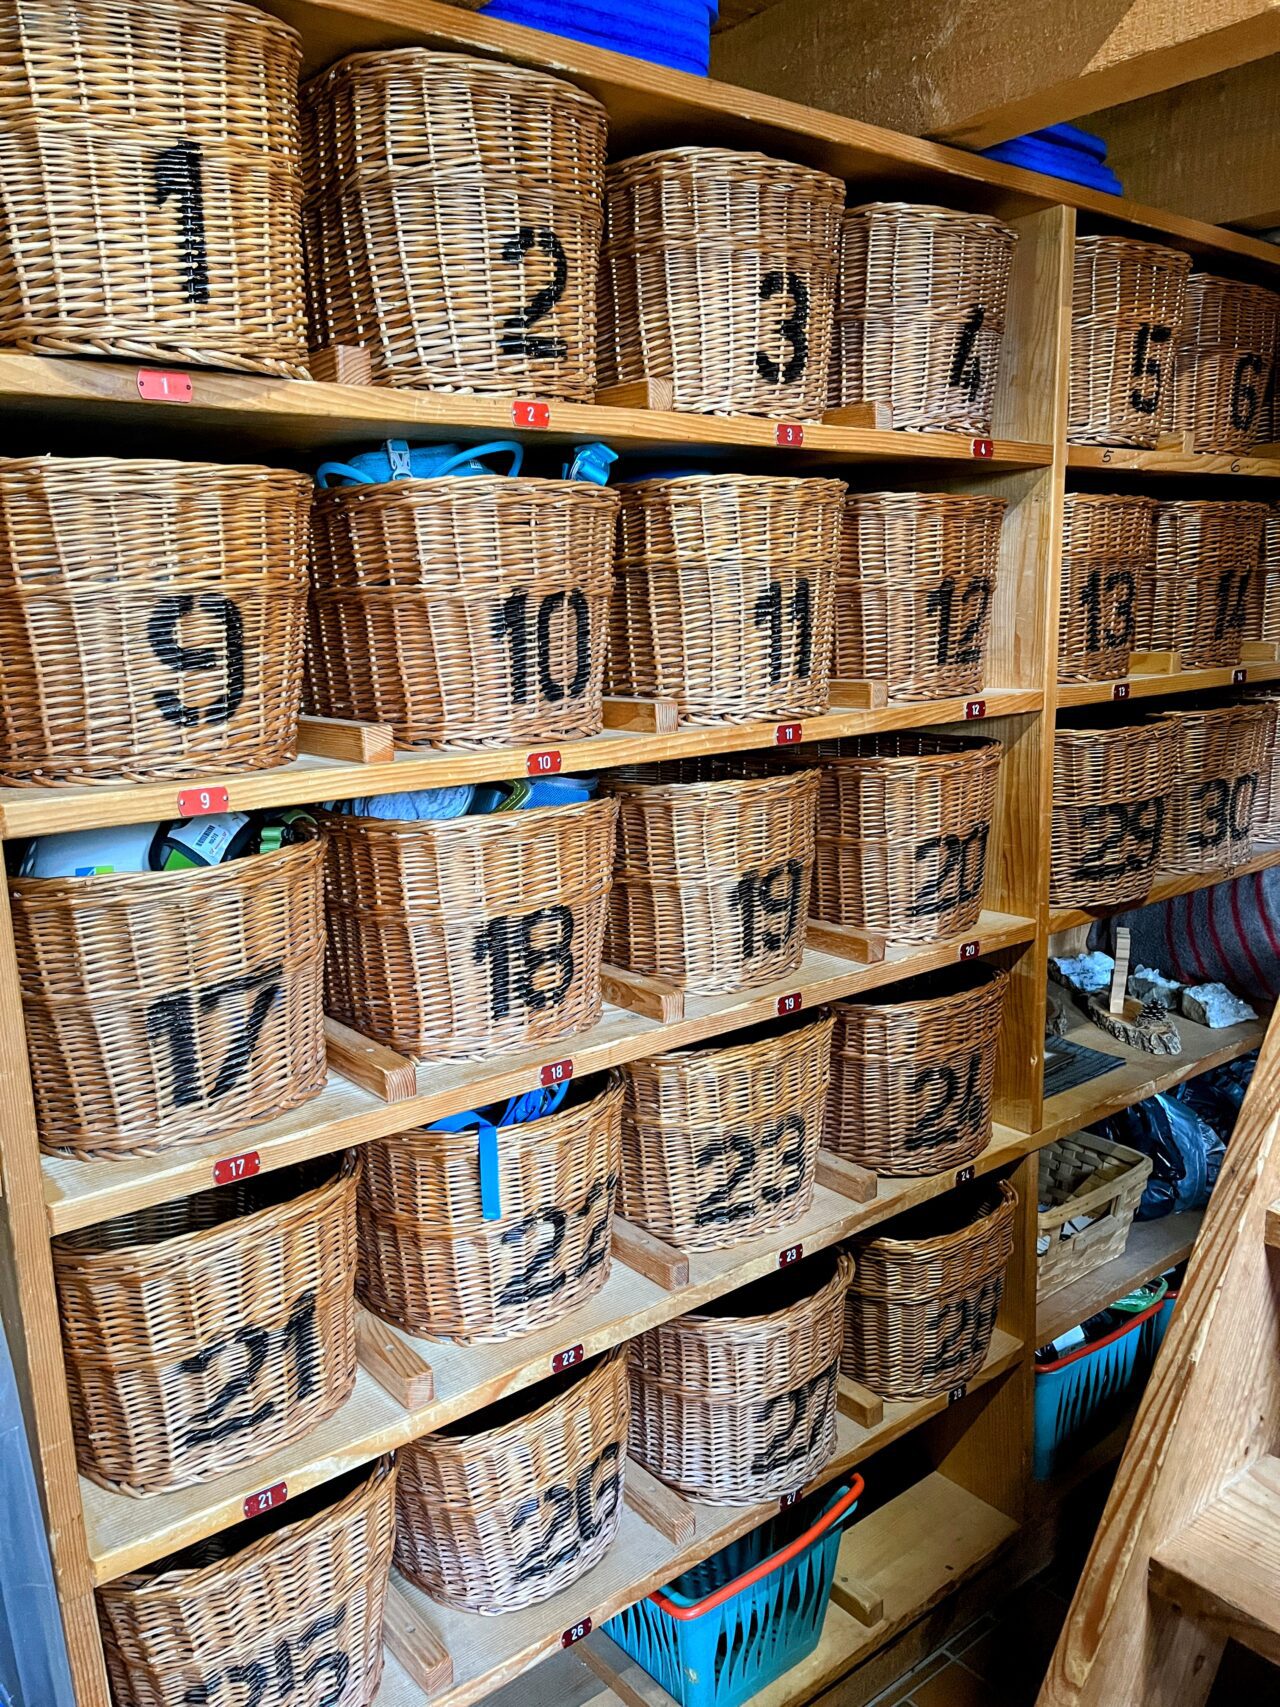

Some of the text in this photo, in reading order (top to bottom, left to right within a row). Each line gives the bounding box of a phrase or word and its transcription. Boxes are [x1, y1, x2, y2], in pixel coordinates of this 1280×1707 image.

[155, 138, 209, 304] 1
[501, 227, 568, 360] 2
[757, 270, 810, 384] 3
[161, 377, 168, 394] 1
[949, 304, 985, 402] 4
[1131, 322, 1172, 414] 5
[527, 406, 535, 422] 2
[1231, 353, 1263, 432] 6
[786, 427, 793, 441] 3
[1101, 450, 1115, 463] 5
[1230, 458, 1241, 473] 6
[493, 586, 592, 704] 10
[754, 578, 812, 686] 11
[927, 575, 990, 665] 12
[1081, 571, 1135, 652] 13
[147, 592, 244, 728] 9
[1118, 688, 1126, 699] 13
[785, 727, 793, 740] 11
[972, 704, 980, 716] 12
[200, 792, 210, 809] 9
[537, 755, 551, 770] 10
[1072, 794, 1165, 880] 29
[1186, 771, 1258, 849] 30
[904, 820, 990, 918] 20
[728, 858, 804, 960] 19
[472, 905, 574, 1019] 18
[965, 944, 975, 957] 20
[147, 963, 284, 1107] 17
[784, 997, 795, 1010] 19
[551, 1065, 563, 1080] 18
[229, 1158, 245, 1177] 17
[694, 1113, 806, 1227] 23
[961, 1170, 970, 1181] 24
[786, 1249, 797, 1262] 23
[173, 1291, 319, 1448] 21
[562, 1350, 575, 1366] 22
[749, 1357, 840, 1475] 27
[257, 1491, 273, 1509] 21
[510, 1442, 620, 1582] 26
[787, 1492, 797, 1505] 27
[571, 1625, 584, 1641] 26
